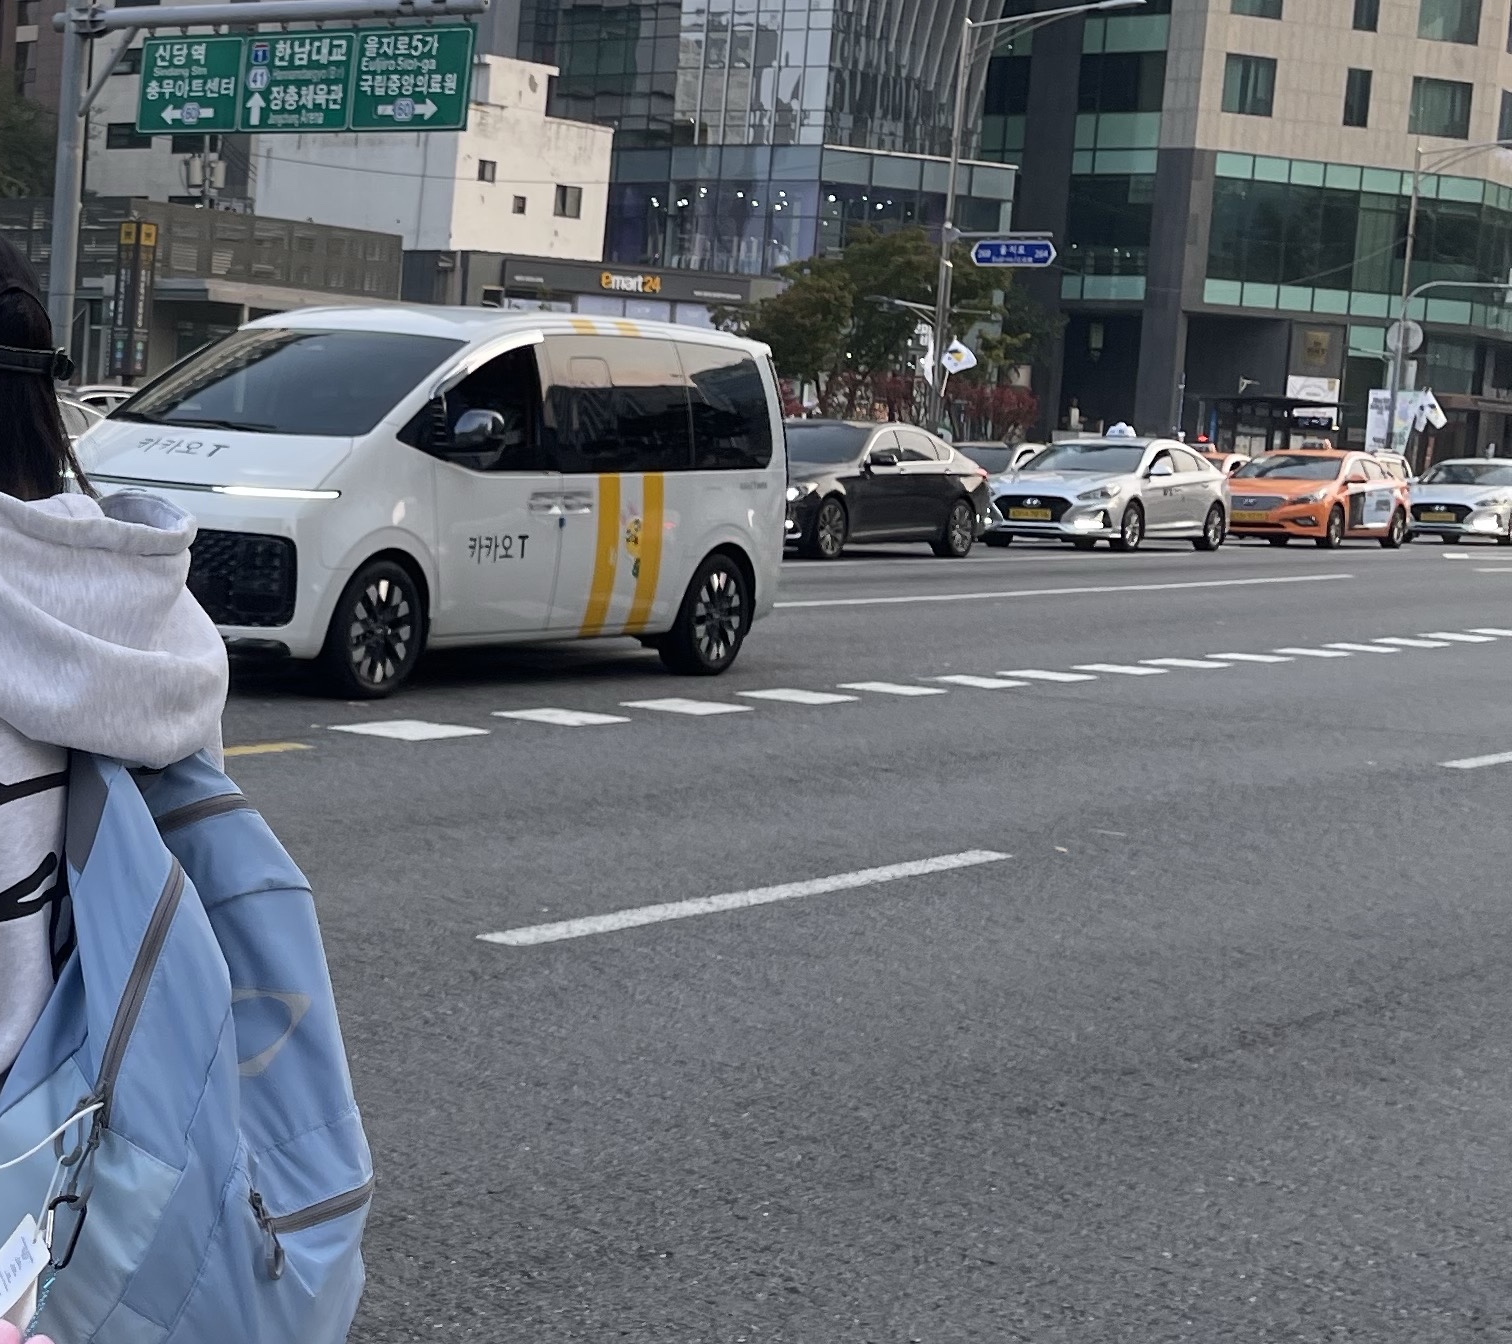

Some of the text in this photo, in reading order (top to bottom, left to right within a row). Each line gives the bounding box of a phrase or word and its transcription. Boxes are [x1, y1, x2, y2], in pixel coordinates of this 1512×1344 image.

[274, 39, 348, 66] 한남대교
[364, 34, 439, 57] 을지로5가
[146, 77, 235, 100] 충무아트센터
[251, 72, 265, 86] 41
[360, 73, 457, 96] 국립중앙의료원
[269, 84, 343, 110] 장충체육관
[600, 271, 662, 294] emart24
[137, 438, 230, 457] 카카오 T
[468, 534, 529, 564] 카카오 T
